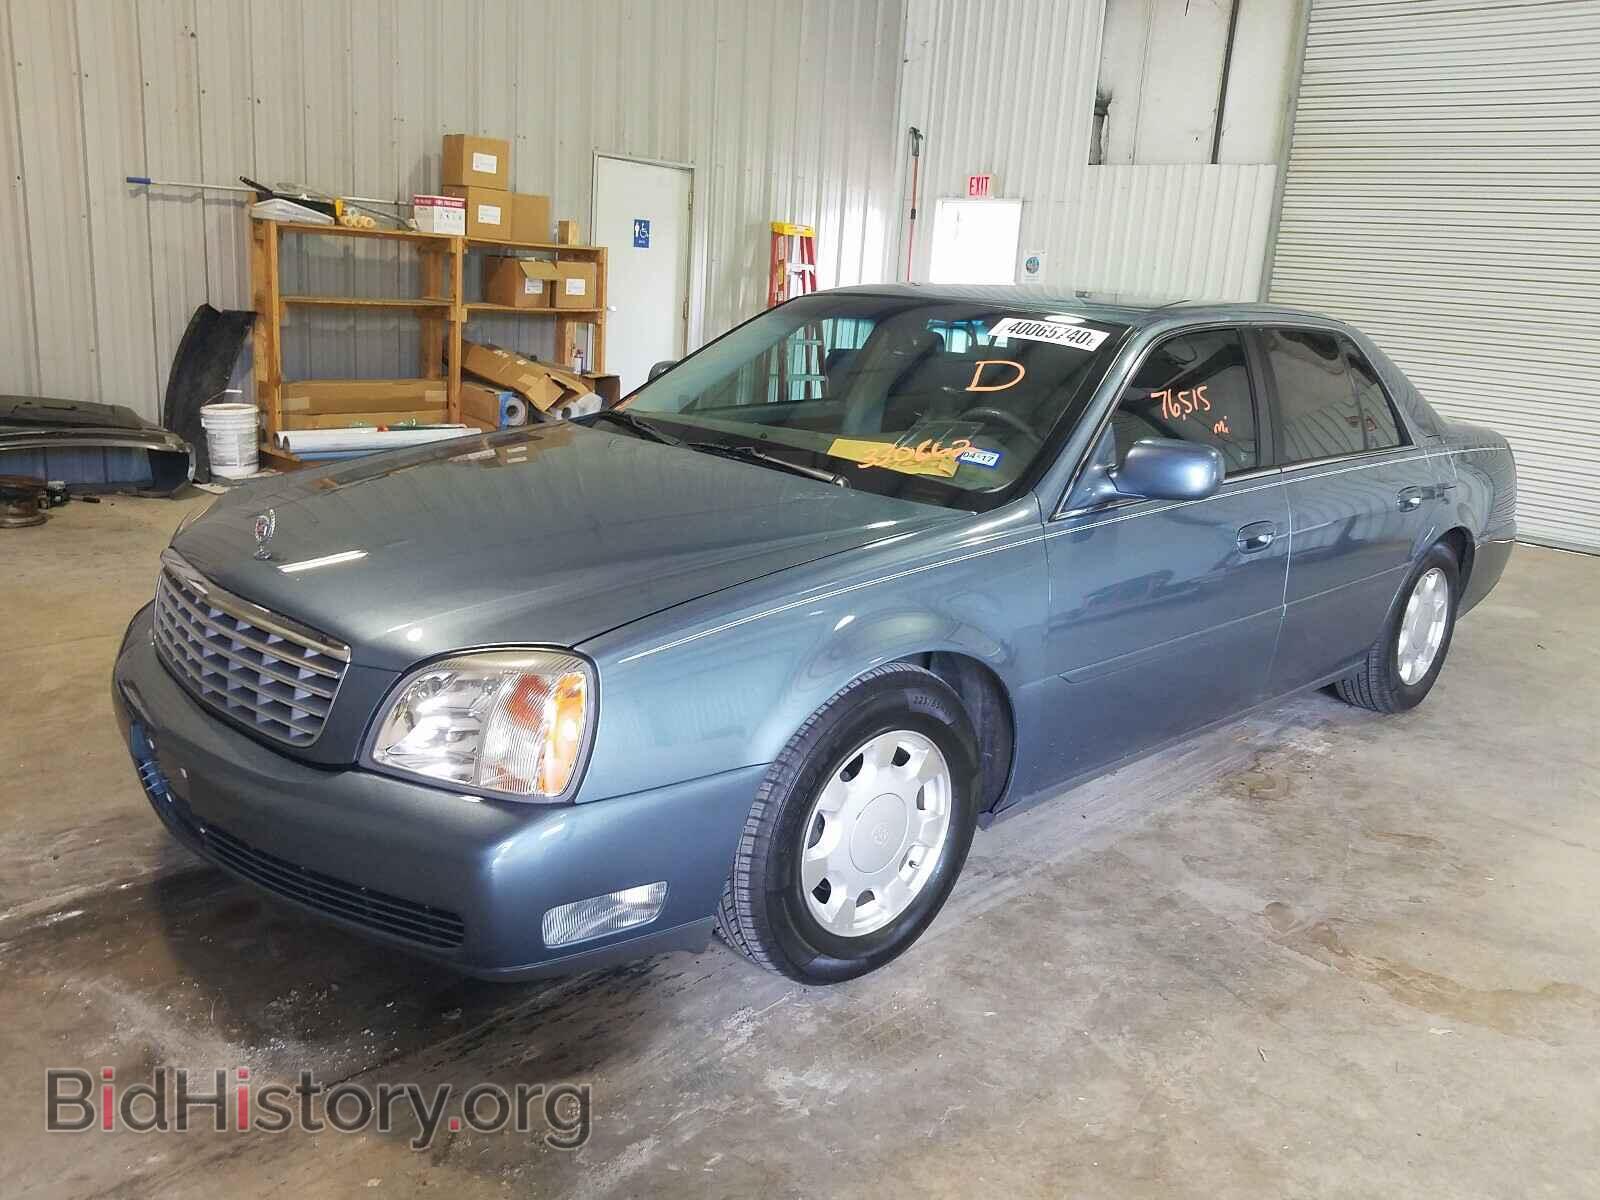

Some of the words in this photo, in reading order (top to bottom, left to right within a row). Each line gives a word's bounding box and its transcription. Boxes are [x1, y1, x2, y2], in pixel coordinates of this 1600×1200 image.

[969, 176, 990, 196] EXIT
[1007, 321, 1093, 345] 40065740
[965, 360, 1025, 391] D
